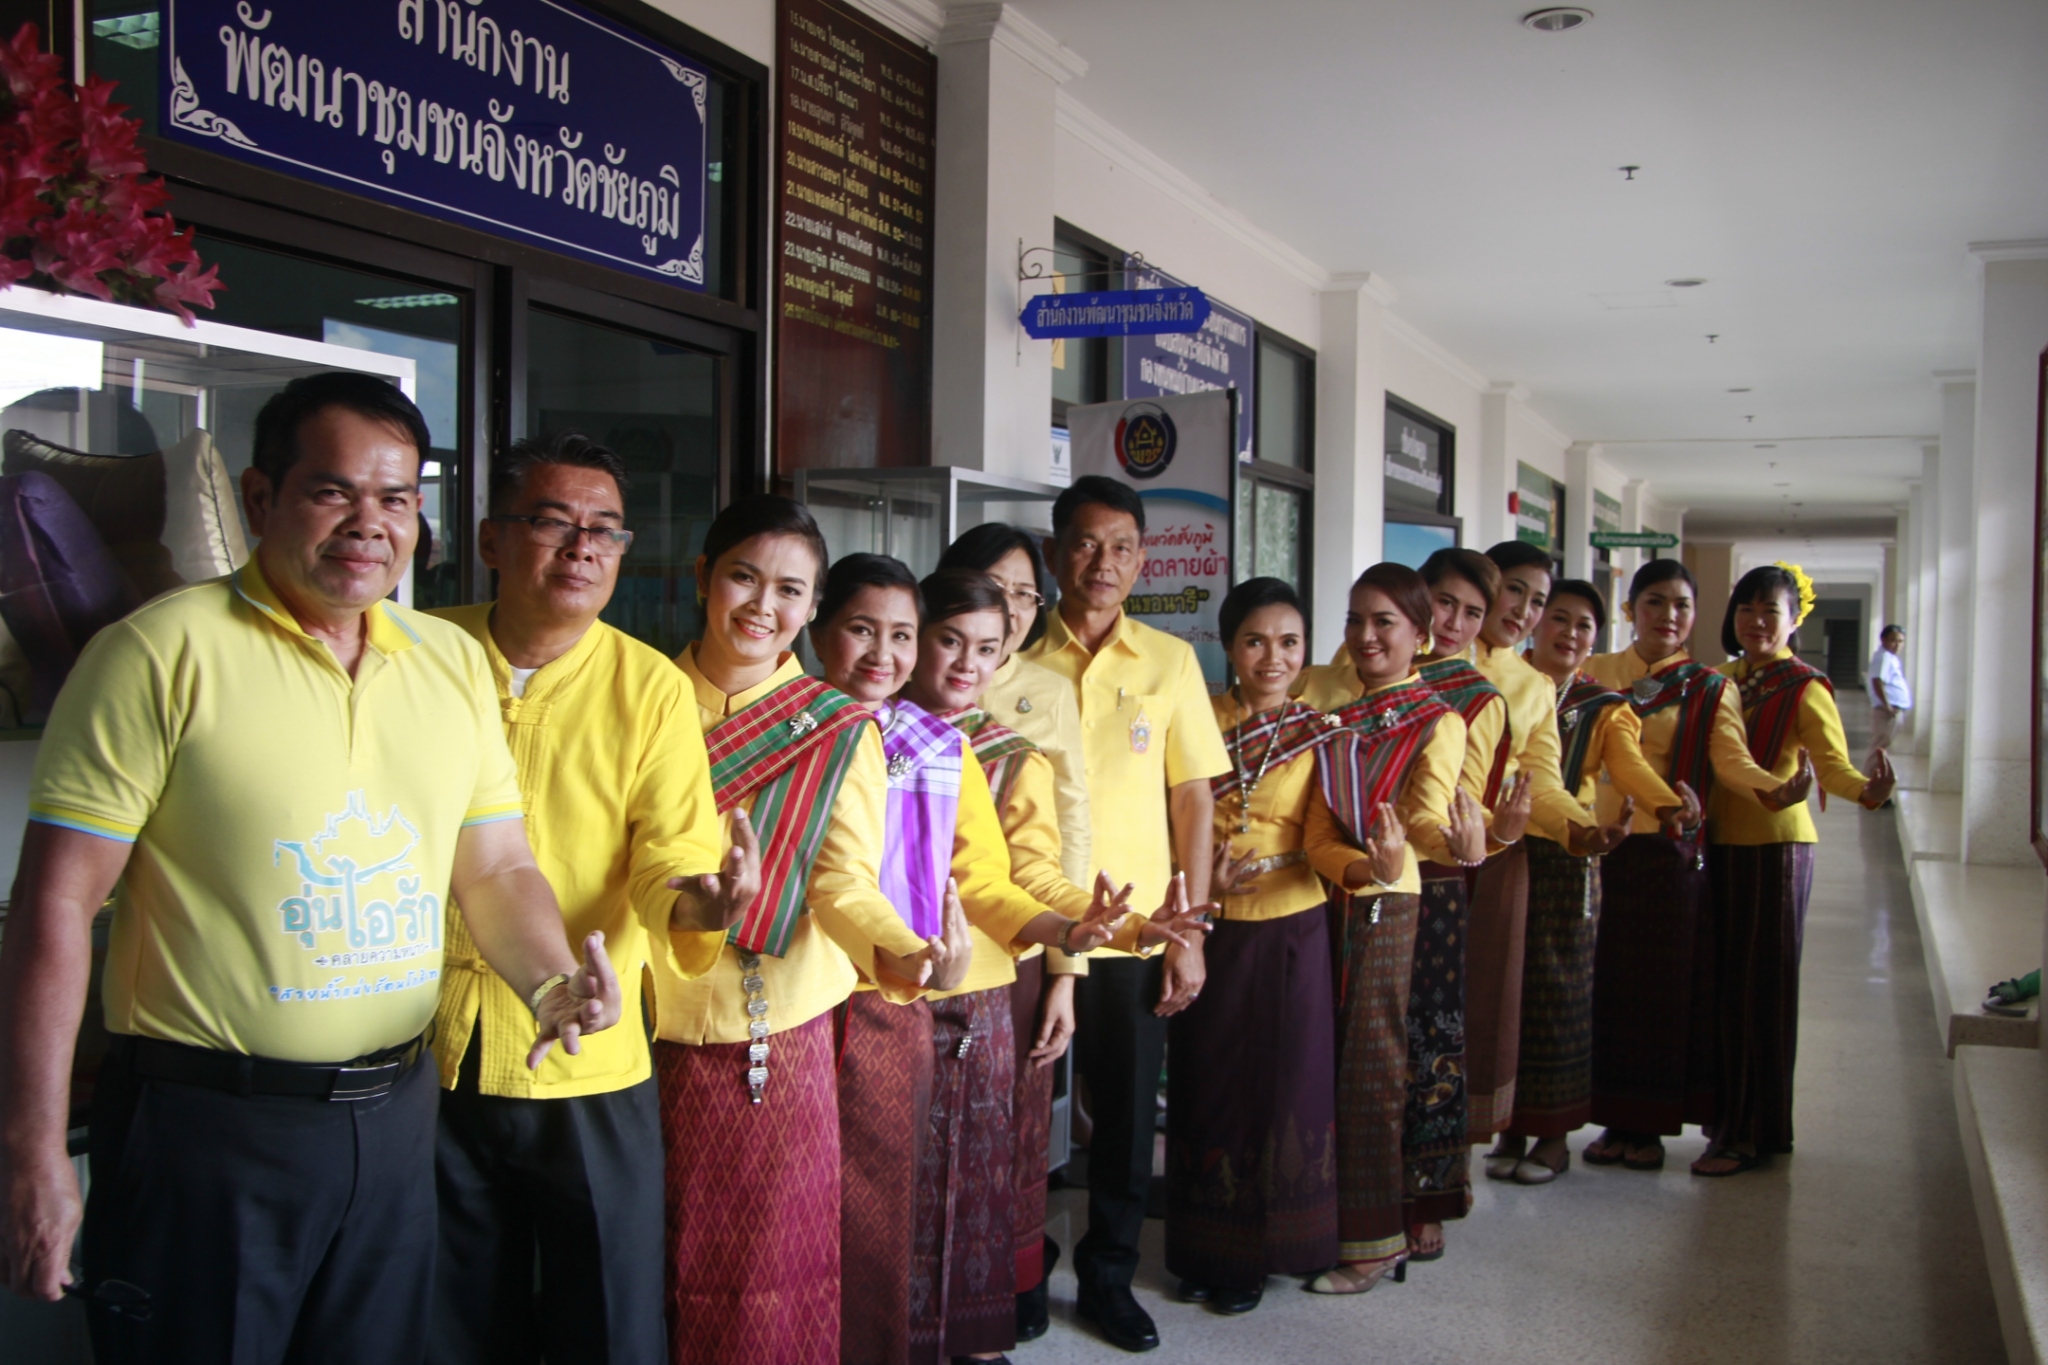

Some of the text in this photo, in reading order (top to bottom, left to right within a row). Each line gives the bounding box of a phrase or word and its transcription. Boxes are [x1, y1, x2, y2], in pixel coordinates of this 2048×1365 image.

[398, 0, 570, 105] สำนกงาน
[219, 0, 681, 256] พัฒนาชุมชนจังหวัดชัยภูมิ
[1037, 293, 1194, 333] สำนักงานพัฒนาชุมชนจังหวัด
[279, 856, 441, 949] อุ่นไอรัก
